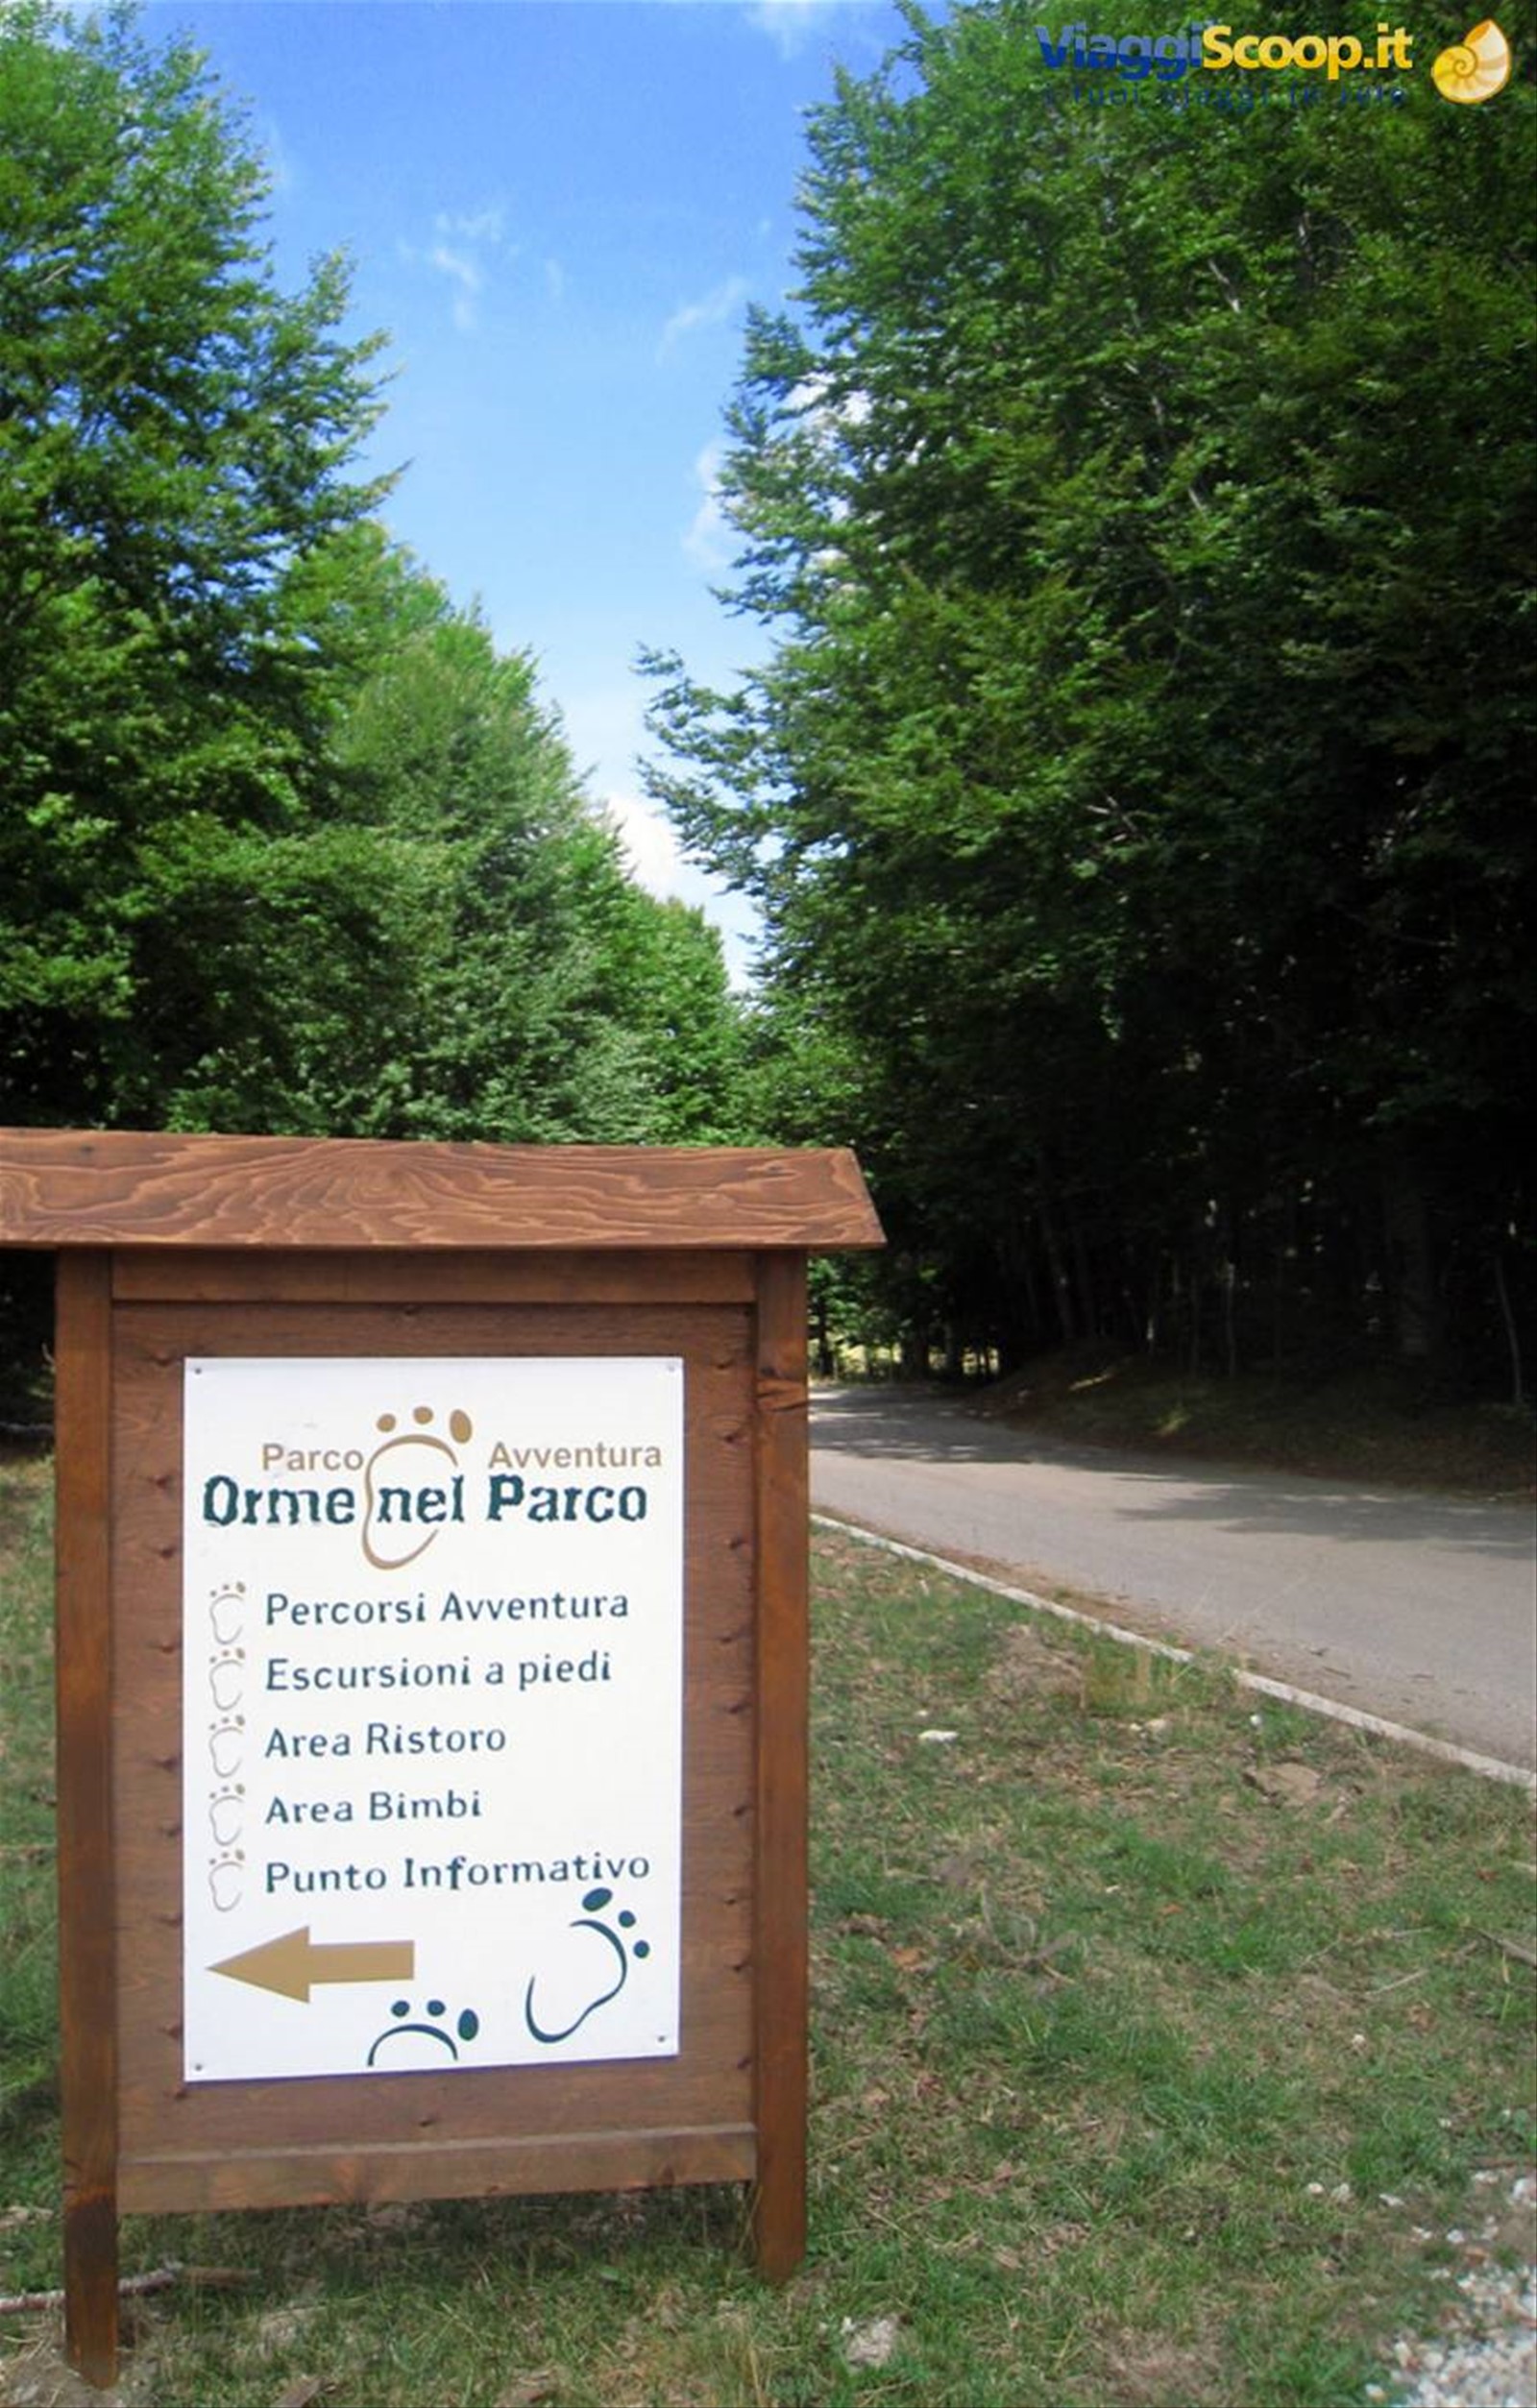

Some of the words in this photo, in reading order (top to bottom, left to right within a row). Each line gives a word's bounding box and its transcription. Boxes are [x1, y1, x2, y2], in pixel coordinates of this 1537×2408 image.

[263, 1443, 364, 1472] Parco
[488, 1442, 662, 1469] Avventura
[203, 1475, 355, 1526] Orme
[377, 1474, 465, 1524] nel
[486, 1473, 647, 1523] Parco
[266, 1592, 427, 1626] Percorsi
[440, 1592, 629, 1622] Avventura
[265, 1656, 471, 1691] Escursioni
[484, 1662, 504, 1686] a
[519, 1649, 611, 1691] piedi
[264, 1727, 351, 1759] Area
[366, 1722, 506, 1755] Ristoro
[264, 1796, 354, 1825] Area
[369, 1789, 481, 1821] Bimbi
[265, 1861, 387, 1894] Punto
[403, 1851, 650, 1889] Informativo
